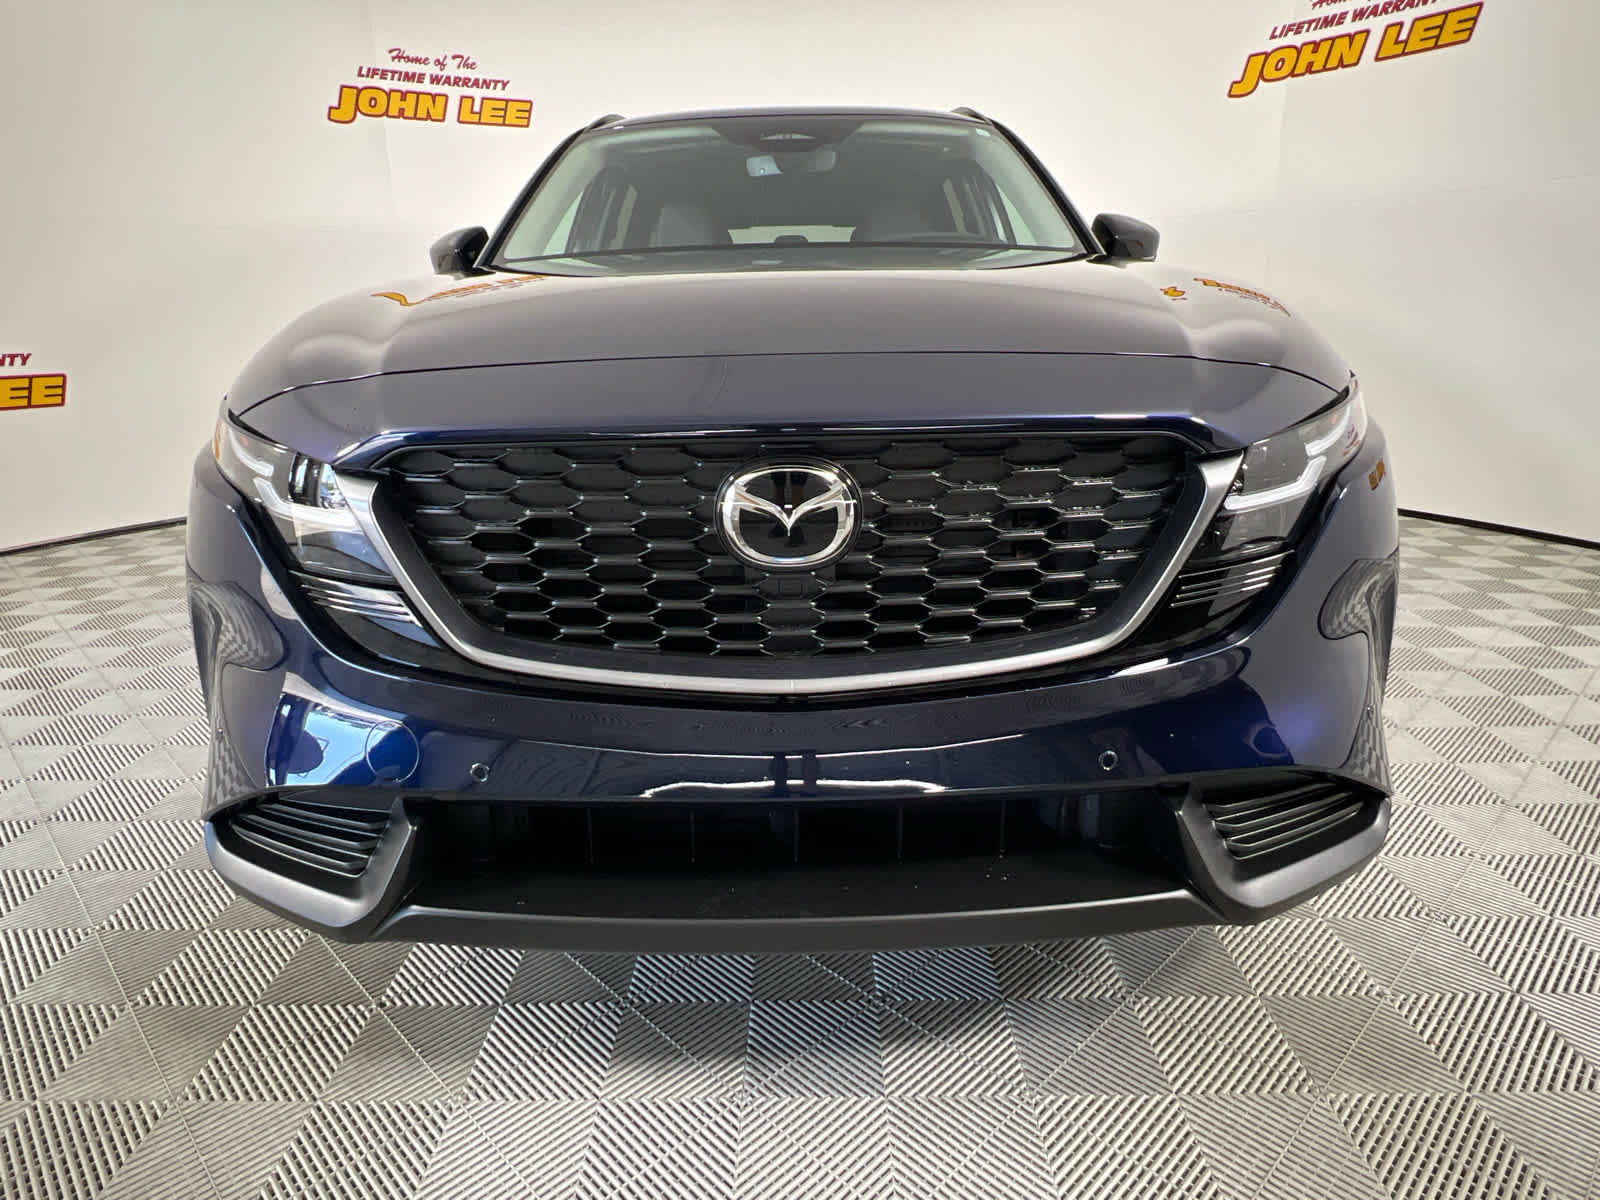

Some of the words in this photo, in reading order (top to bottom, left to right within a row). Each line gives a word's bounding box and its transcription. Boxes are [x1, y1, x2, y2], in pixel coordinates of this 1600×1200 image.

[1269, 11, 1348, 40] LIFETIME
[388, 48, 430, 65] Home
[433, 55, 447, 71] of
[451, 54, 476, 70] The
[1228, 29, 1371, 98] JOHN
[1374, 2, 1484, 62] LEE
[357, 66, 425, 84] LIFETIME
[429, 75, 510, 91] WARRANTY
[328, 85, 448, 124] JOHN
[457, 96, 533, 128] LEE
